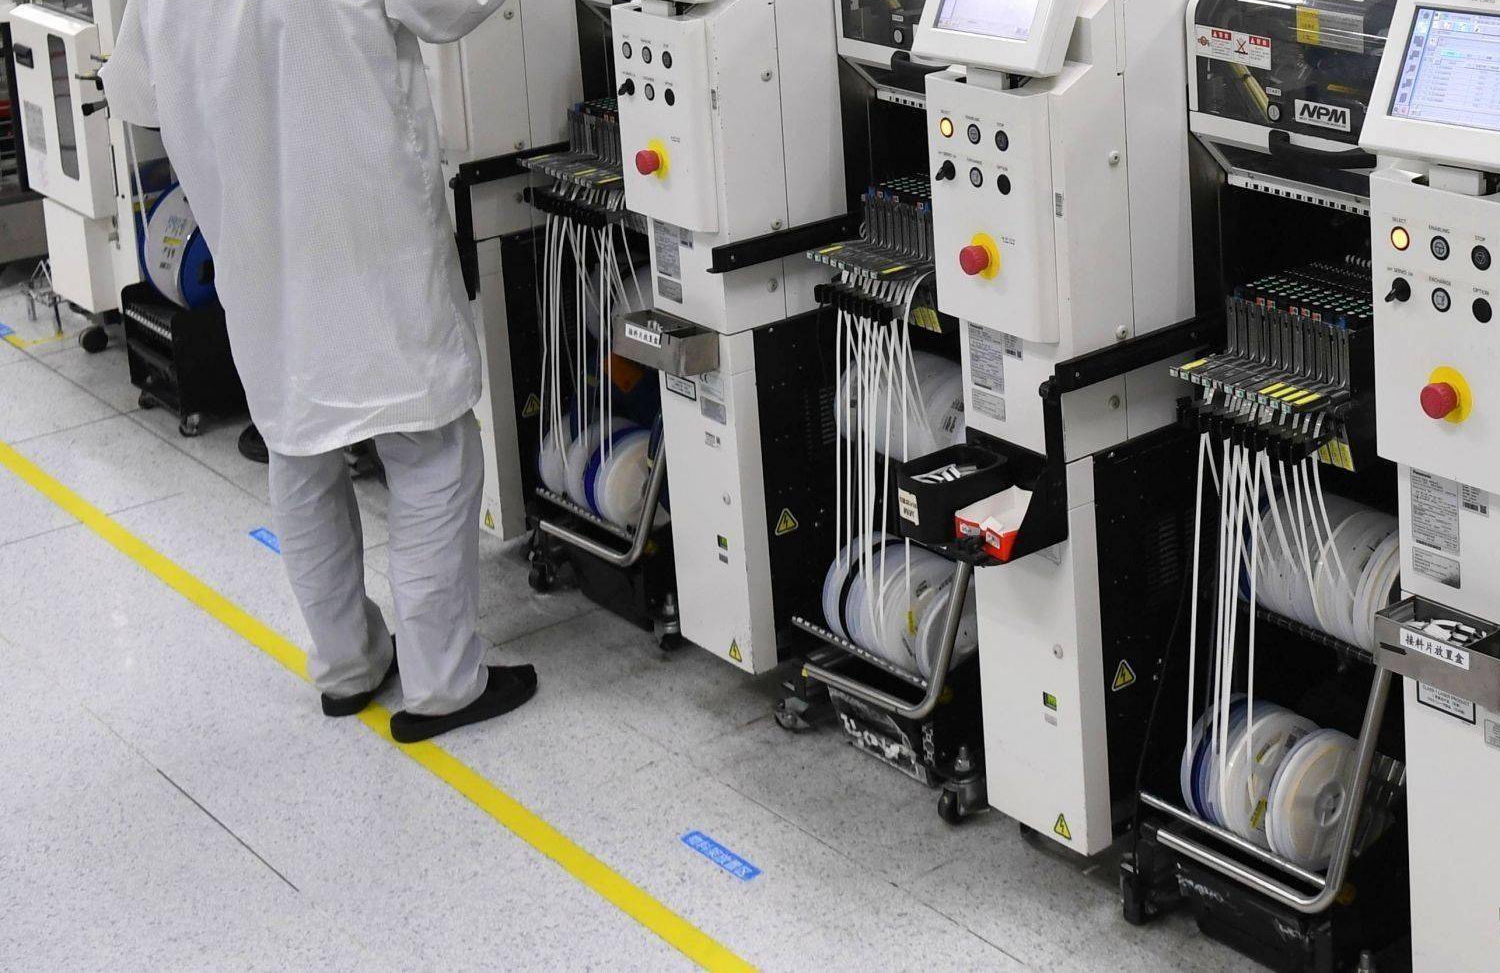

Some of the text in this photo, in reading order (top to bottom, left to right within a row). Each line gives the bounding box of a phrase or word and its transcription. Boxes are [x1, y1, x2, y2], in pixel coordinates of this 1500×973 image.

[1300, 104, 1347, 124] NPM
[1405, 633, 1464, 665] 接料片放置盒
